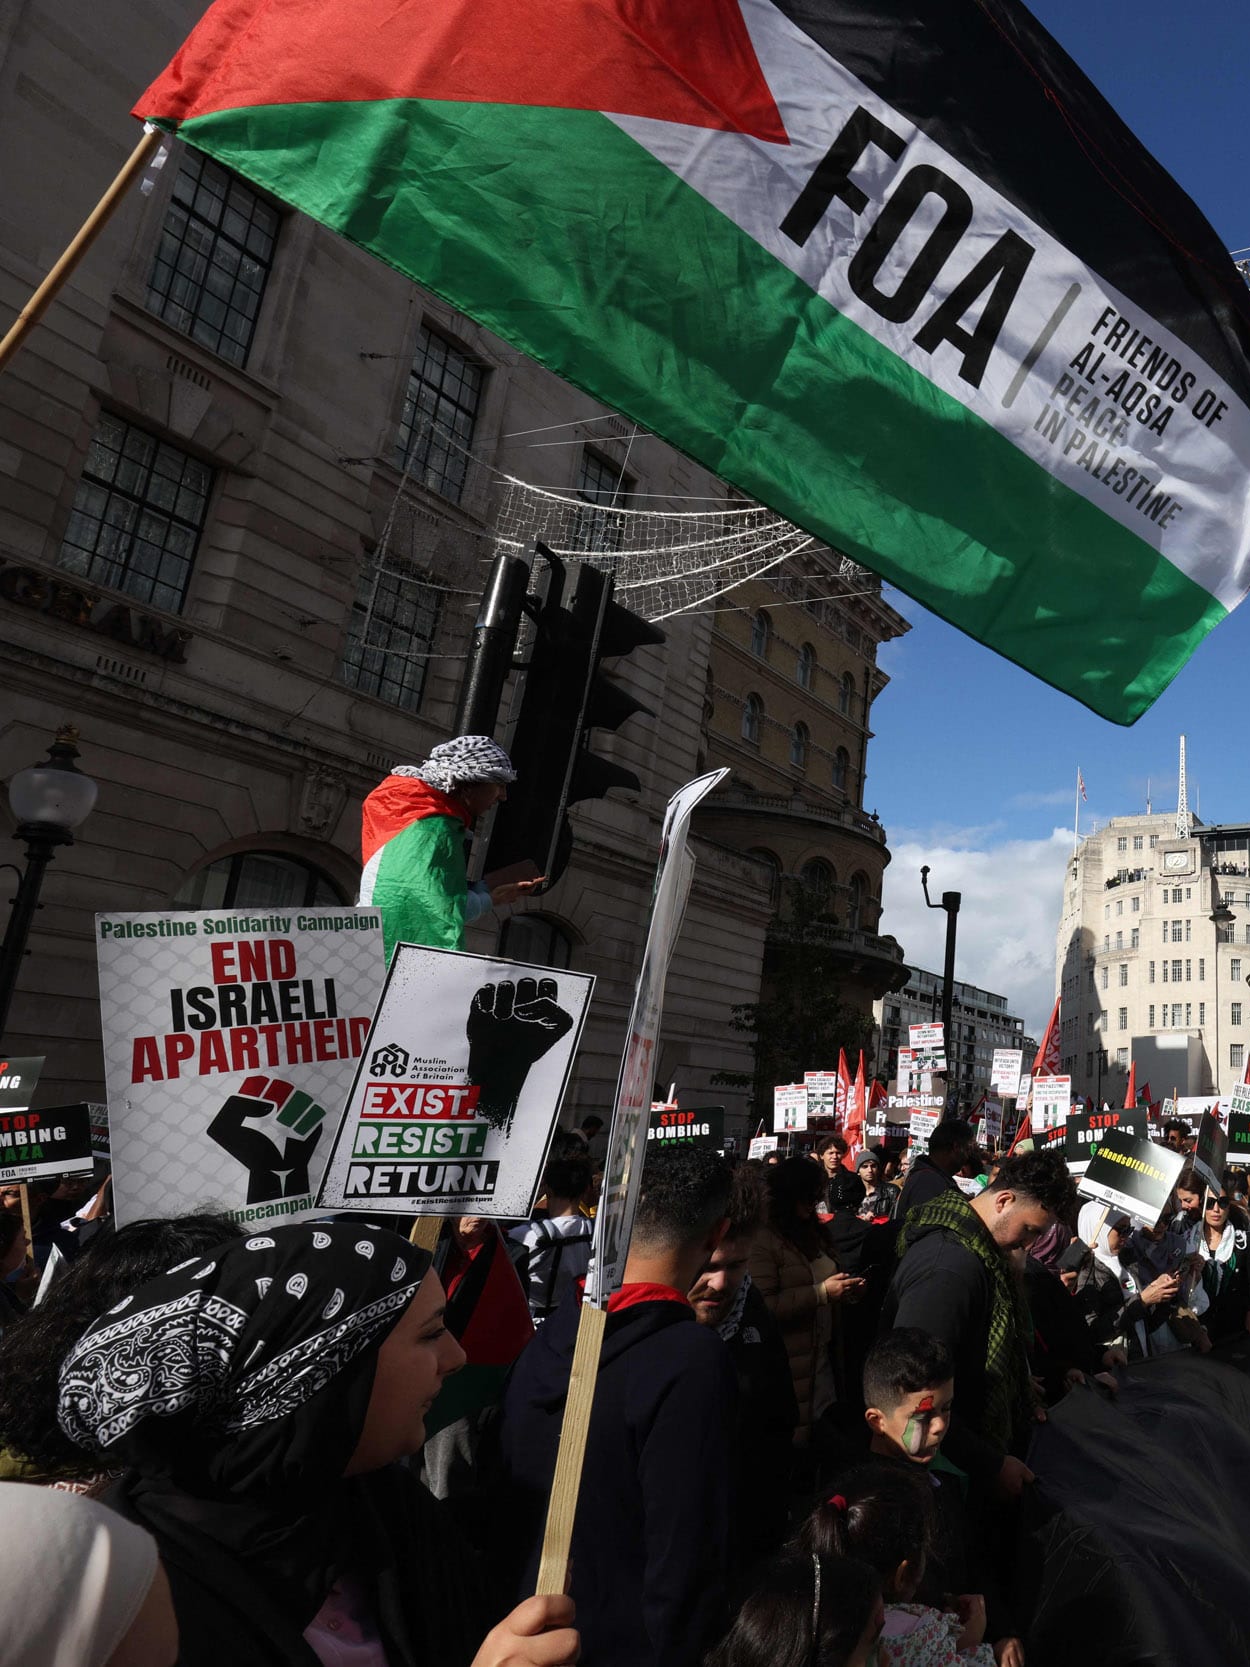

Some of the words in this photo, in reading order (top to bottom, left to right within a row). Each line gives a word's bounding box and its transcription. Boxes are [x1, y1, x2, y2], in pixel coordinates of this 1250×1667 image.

[778, 104, 1036, 390] FOA
[1091, 306, 1197, 403] FRIENDS
[1191, 388, 1229, 428] OF
[1069, 341, 1175, 437] AL-AQSA
[1050, 372, 1130, 448] PEACE
[1033, 403, 1067, 444] IN
[1063, 429, 1183, 530] PALESTINE
[101, 919, 197, 939] Palestine
[203, 915, 292, 935] Solidarity
[298, 913, 380, 932] Campaign
[210, 939, 297, 985] END
[170, 978, 338, 1032] ISRAELI
[131, 1016, 372, 1084] APARTHEID
[413, 1056, 447, 1065] Muslim
[411, 1064, 465, 1073] Association
[362, 1086, 476, 1116] EXIST.
[888, 1094, 944, 1108] Palestine
[2, 1113, 41, 1132] TOP
[648, 1123, 710, 1140] BOMBING
[660, 1112, 695, 1126] STOP
[1089, 1113, 1120, 1129] STOP
[0, 1126, 67, 1147] MBING
[354, 1126, 483, 1154] RESIST.
[2, 1144, 44, 1163] AZA
[345, 1164, 494, 1194] RETURN.
